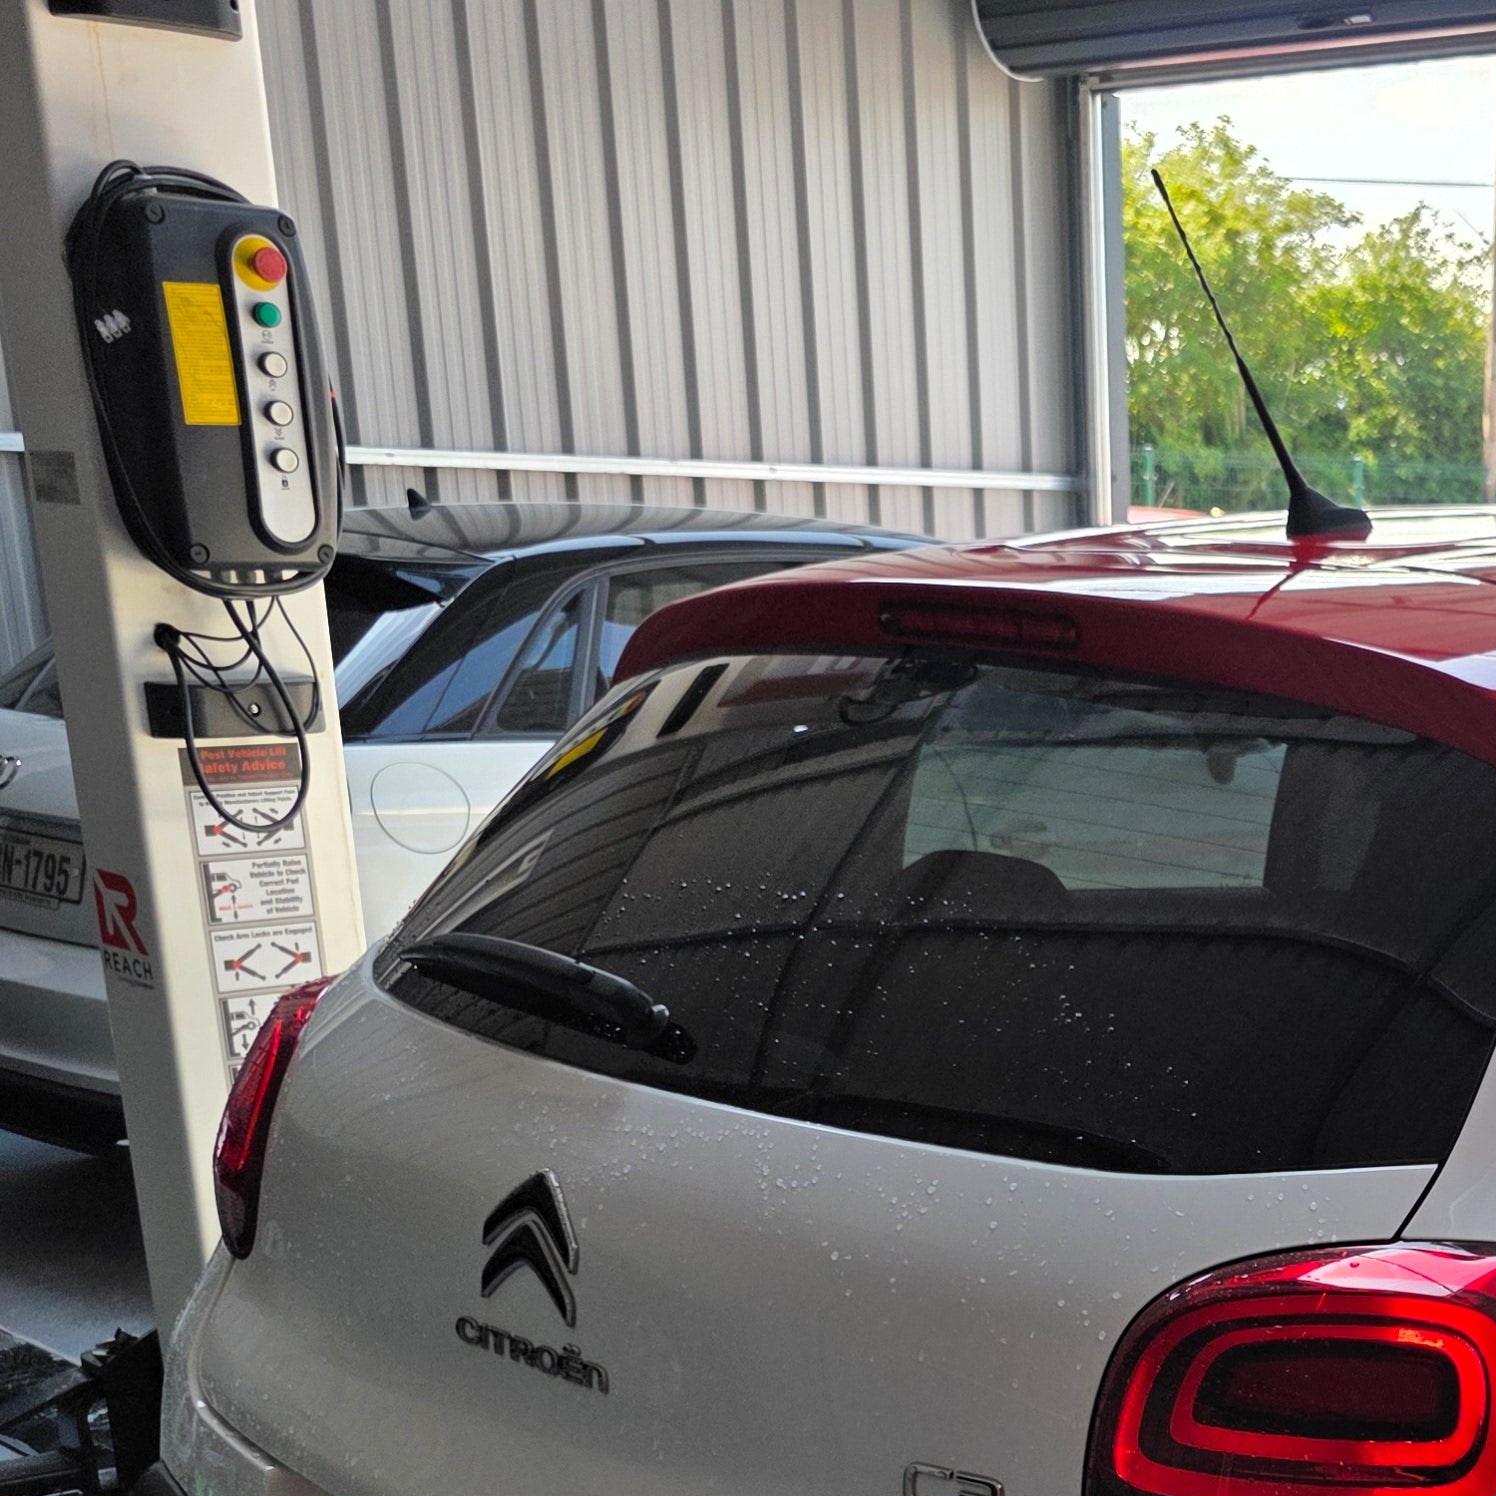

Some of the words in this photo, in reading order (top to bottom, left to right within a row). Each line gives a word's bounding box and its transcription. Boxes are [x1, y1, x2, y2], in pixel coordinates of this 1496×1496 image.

[227, 747, 267, 758] Vehicle
[242, 760, 286, 771] Advice
[0, 843, 71, 896] N-1795
[249, 870, 275, 879] Vehicle
[285, 868, 307, 876] Check
[259, 878, 285, 888] Correct
[275, 905, 300, 913] Vehicle
[213, 934, 235, 942] Check
[104, 951, 153, 980] REACH
